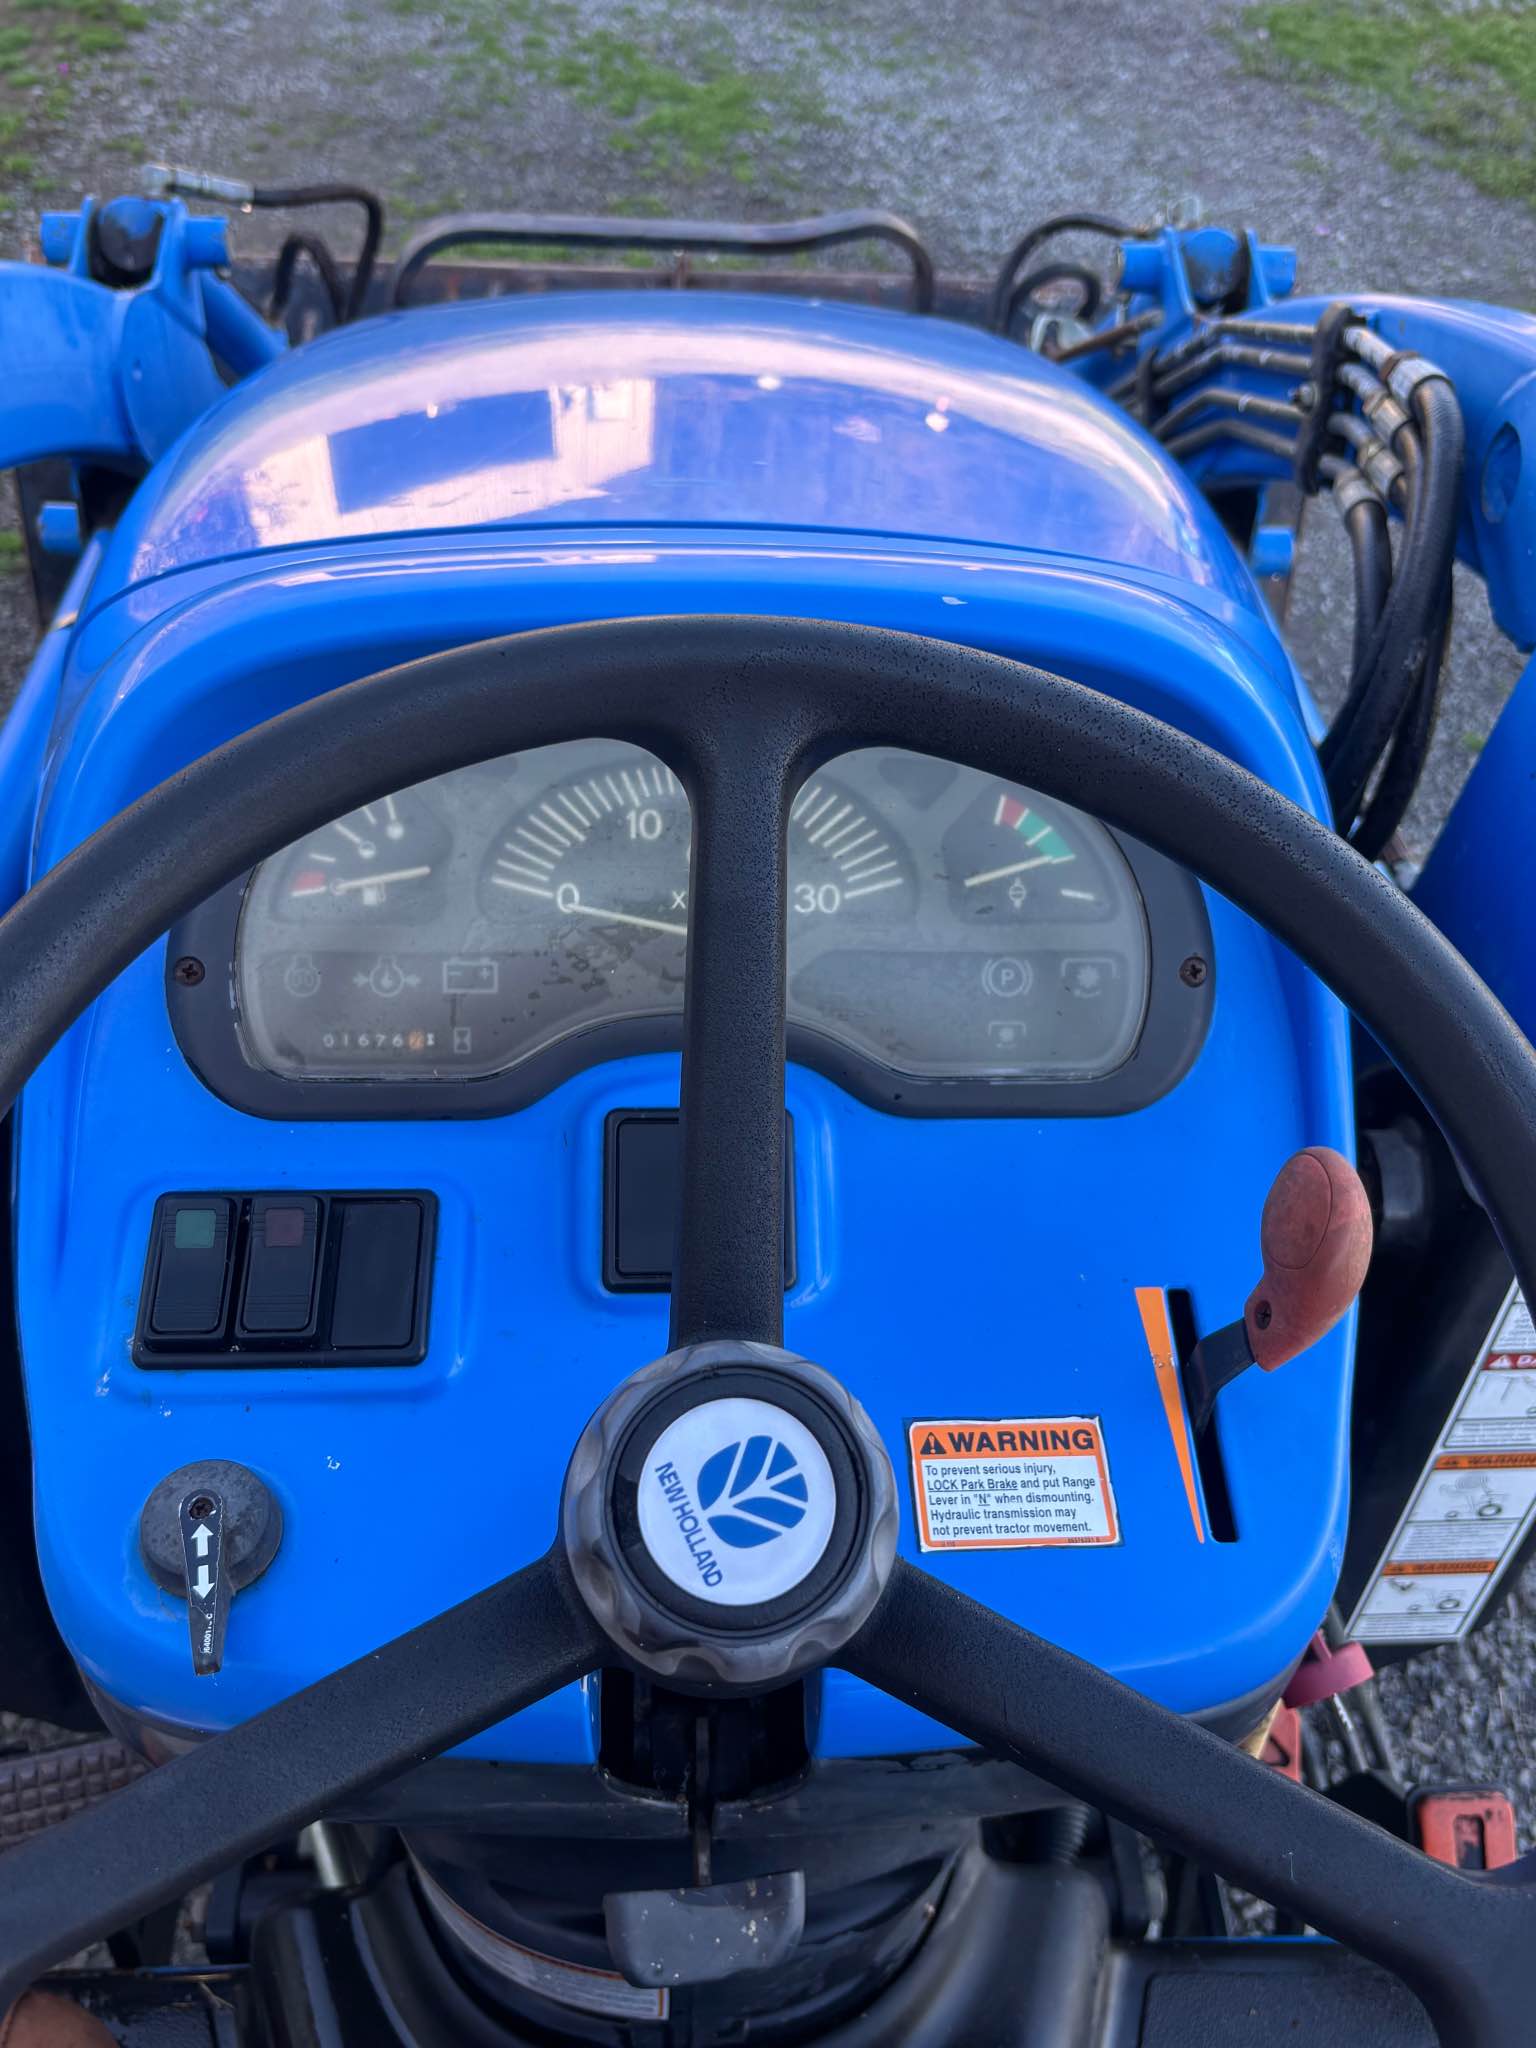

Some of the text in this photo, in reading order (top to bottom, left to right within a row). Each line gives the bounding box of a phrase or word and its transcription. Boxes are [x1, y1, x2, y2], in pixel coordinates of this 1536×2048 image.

[626, 808, 663, 840] 10
[556, 882, 580, 914] 0
[793, 883, 841, 914] 30
[948, 1429, 1094, 1452] WARNING
[925, 1462, 1056, 1478] To prevent serious injury,
[927, 1476, 1096, 1491] LOCK Park Brake and put Range
[928, 1495, 958, 1505] Lever
[961, 1494, 971, 1504] in
[994, 1493, 1023, 1503] when
[1025, 1491, 1094, 1504] dismounting.
[655, 1461, 723, 1587] NEW HOLLAND
[931, 1507, 1076, 1523] Hydraulic transmission may
[933, 1521, 1092, 1537] not prevent tractor movement.
